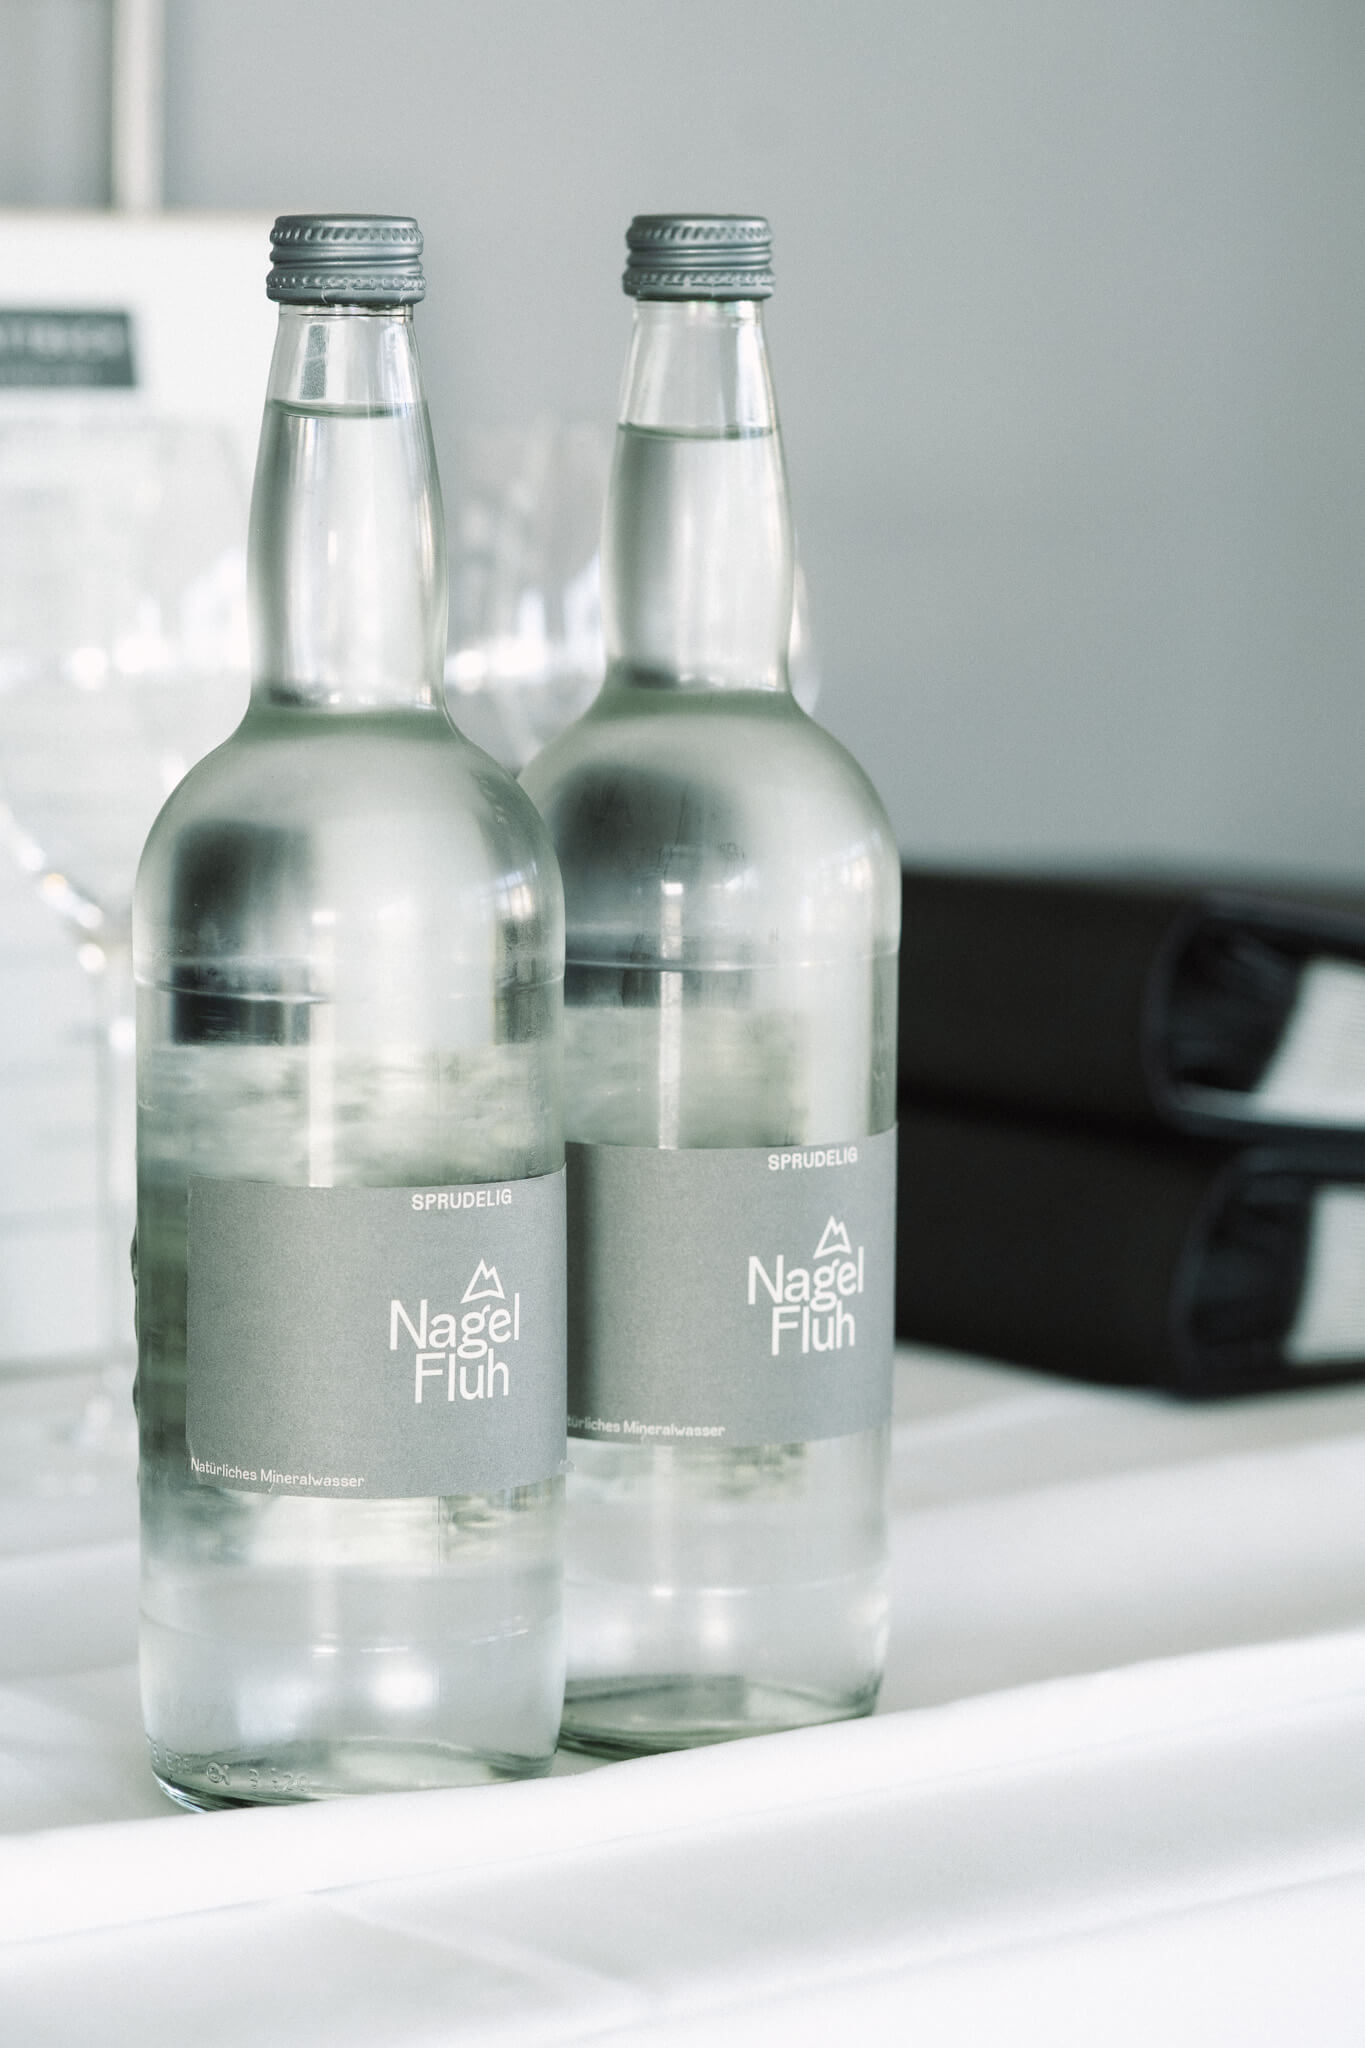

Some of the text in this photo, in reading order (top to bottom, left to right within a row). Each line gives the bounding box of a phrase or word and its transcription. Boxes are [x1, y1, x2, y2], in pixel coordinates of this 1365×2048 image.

[768, 1147, 858, 1171] SPRUDELIG
[411, 1189, 512, 1210] SPRUDELIG
[748, 1246, 864, 1312] Nagel
[389, 1293, 520, 1359] Nagel
[771, 1300, 855, 1356] Fluh
[415, 1348, 509, 1403] Fluh
[567, 1415, 726, 1437] türliches Mineralwasser
[190, 1457, 365, 1487] Natürliches Mineralwasser
